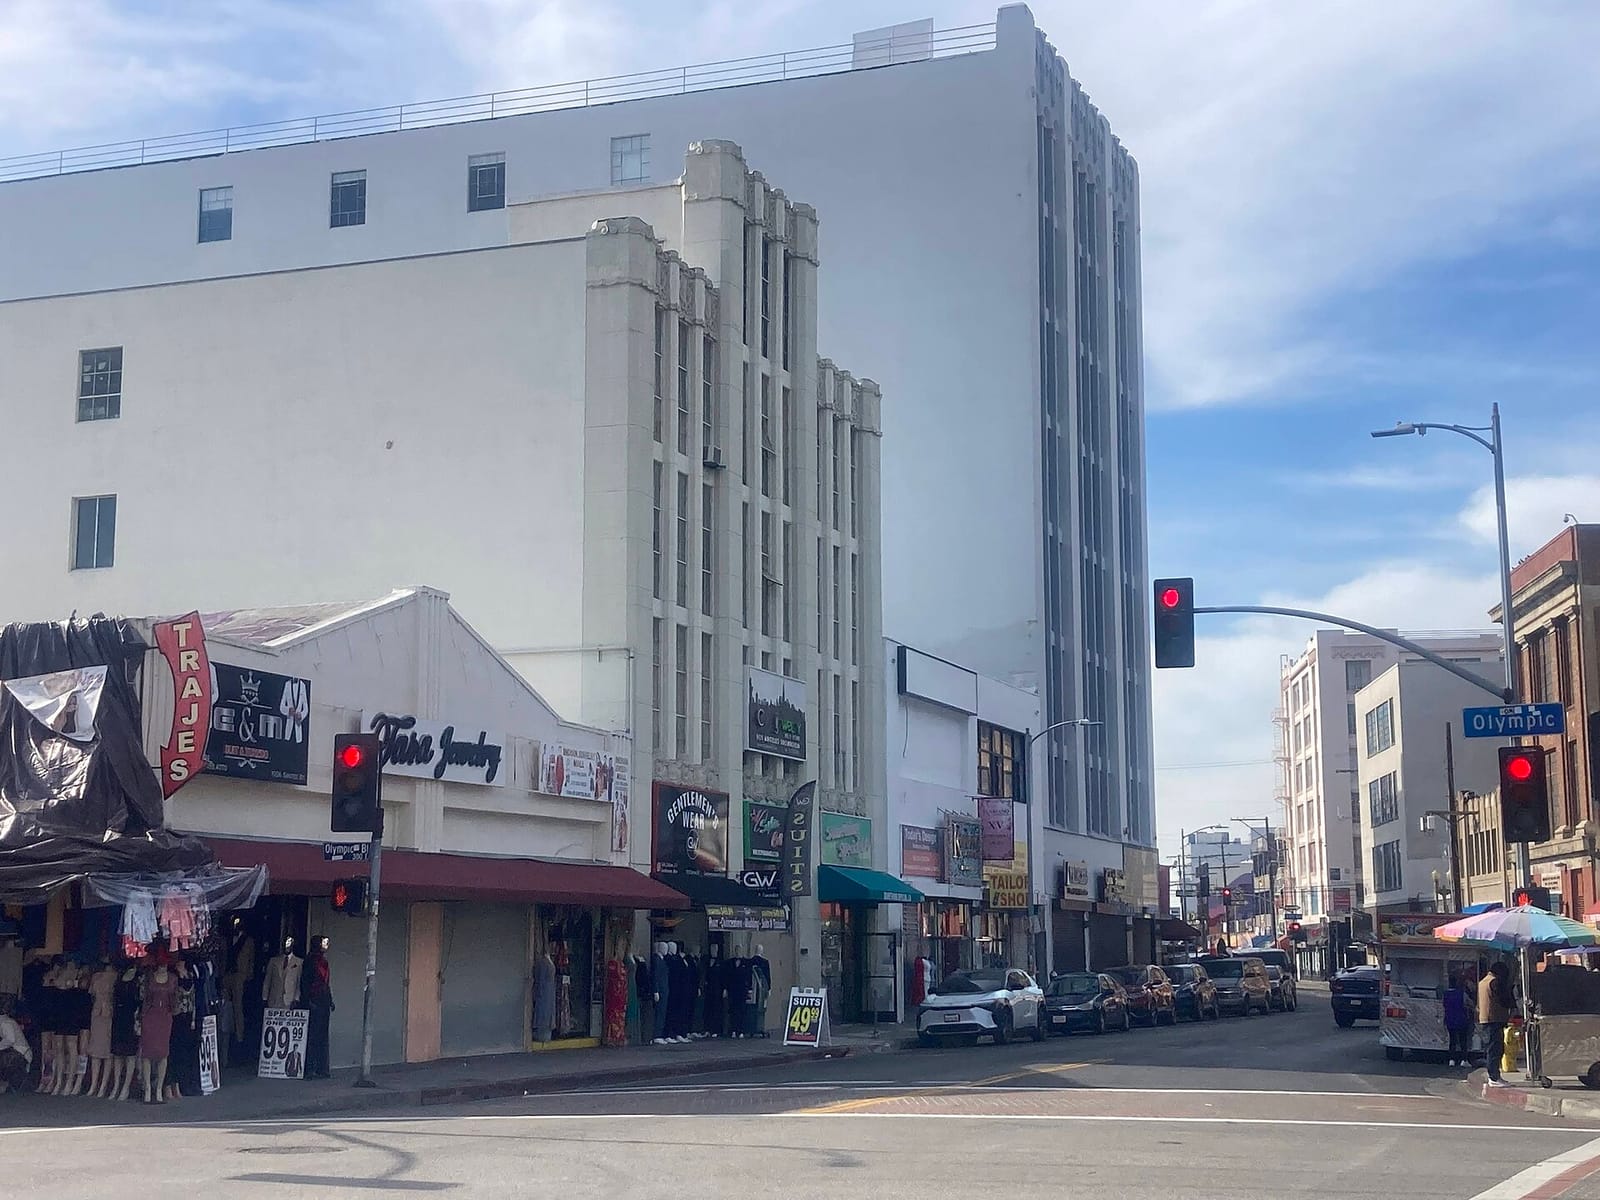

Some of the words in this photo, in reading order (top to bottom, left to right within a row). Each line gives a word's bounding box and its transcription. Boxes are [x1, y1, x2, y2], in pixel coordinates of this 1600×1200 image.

[169, 622, 205, 782] TRAJES
[1473, 715, 1555, 733] Olympic
[682, 811, 705, 830] WEAR
[325, 843, 354, 855] Olympic
[743, 871, 777, 888] GW
[793, 997, 821, 1006] SUITS
[267, 1010, 306, 1018] SPECIAL
[790, 1007, 811, 1032] 49
[263, 1026, 291, 1060] 99
[292, 1027, 304, 1040] 99
